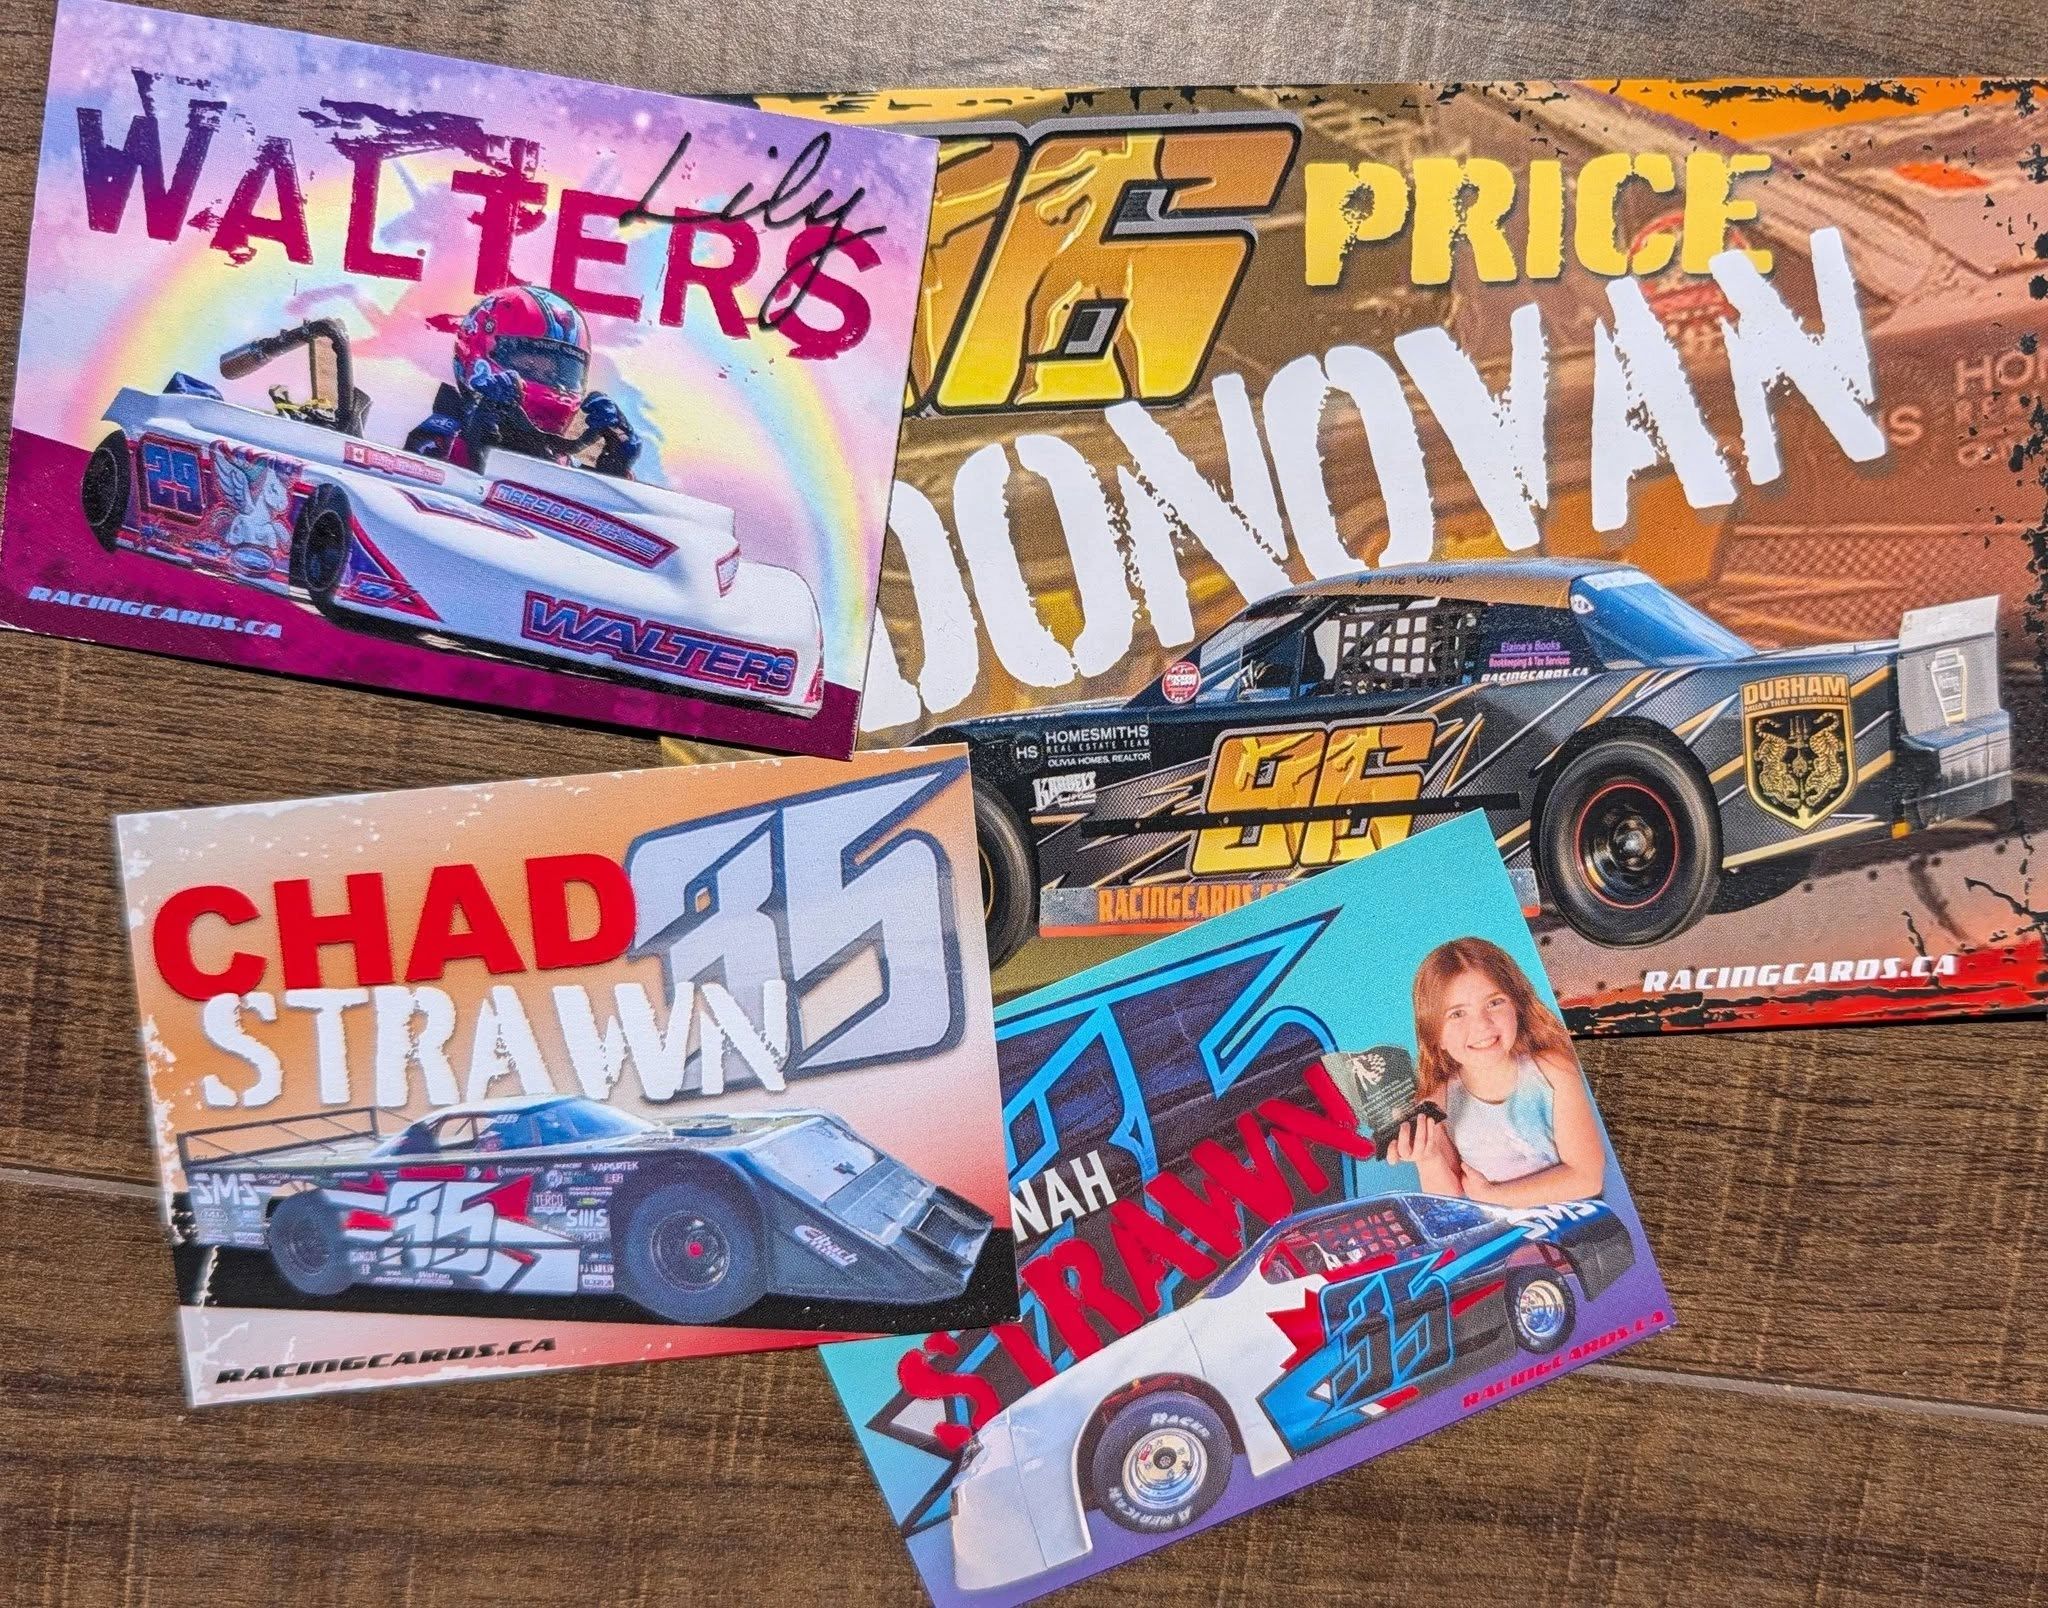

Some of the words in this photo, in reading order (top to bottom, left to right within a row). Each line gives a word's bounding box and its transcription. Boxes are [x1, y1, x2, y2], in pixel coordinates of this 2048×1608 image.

[76, 70, 882, 360] WALTERS
[619, 131, 888, 331] Lily
[1303, 153, 1773, 287] PRICE
[143, 443, 200, 518] 29
[858, 227, 1889, 733] DONOVAN
[28, 586, 283, 639] RACINGCARDS.CA
[531, 600, 796, 689] WALTERS
[1534, 640, 1561, 651] Books
[1480, 666, 1591, 682] RACINGCARDS.CA
[1743, 676, 1847, 706] DURHAM
[1015, 745, 1038, 759] HS
[1045, 724, 1150, 745] HOMESMITHS
[1046, 744, 1073, 755] REAL
[1078, 740, 1118, 752] ESTATE
[1123, 738, 1151, 748] TEAM
[1047, 757, 1078, 768] OLIVIA
[1111, 751, 1152, 763] REALTOR
[152, 852, 638, 999] CHAD
[1642, 955, 1958, 993] RACINGCARDS.CA
[200, 978, 790, 1109] STRAWN
[215, 1337, 557, 1385] RACINGCARDS.CA
